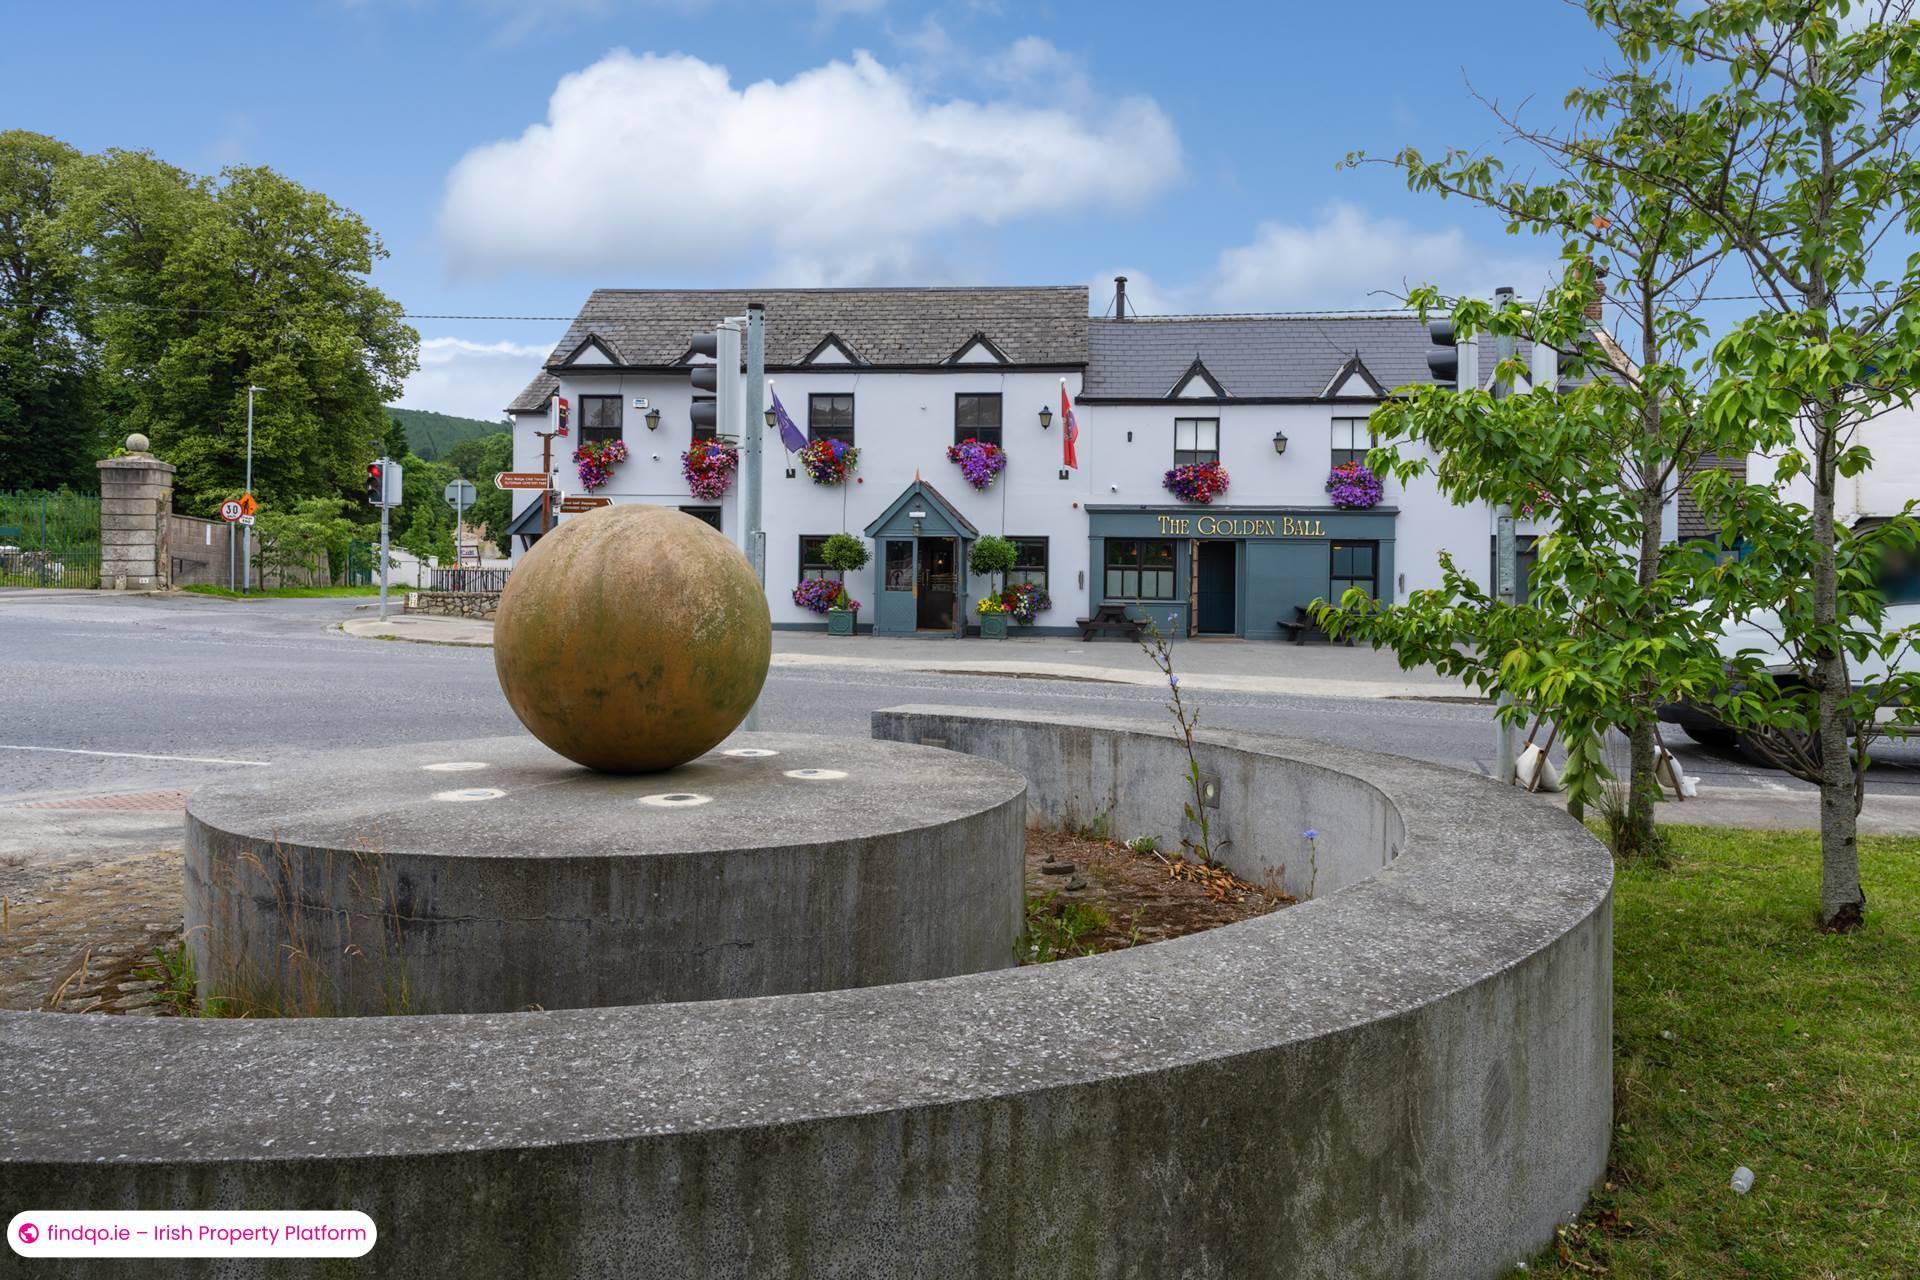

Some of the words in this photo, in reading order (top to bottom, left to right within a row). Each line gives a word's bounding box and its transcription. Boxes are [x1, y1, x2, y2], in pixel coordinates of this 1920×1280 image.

[226, 505, 238, 514] 30
[1158, 516, 1190, 534] THE
[1197, 516, 1275, 535] GOLDEN
[1283, 516, 1326, 536] BALL
